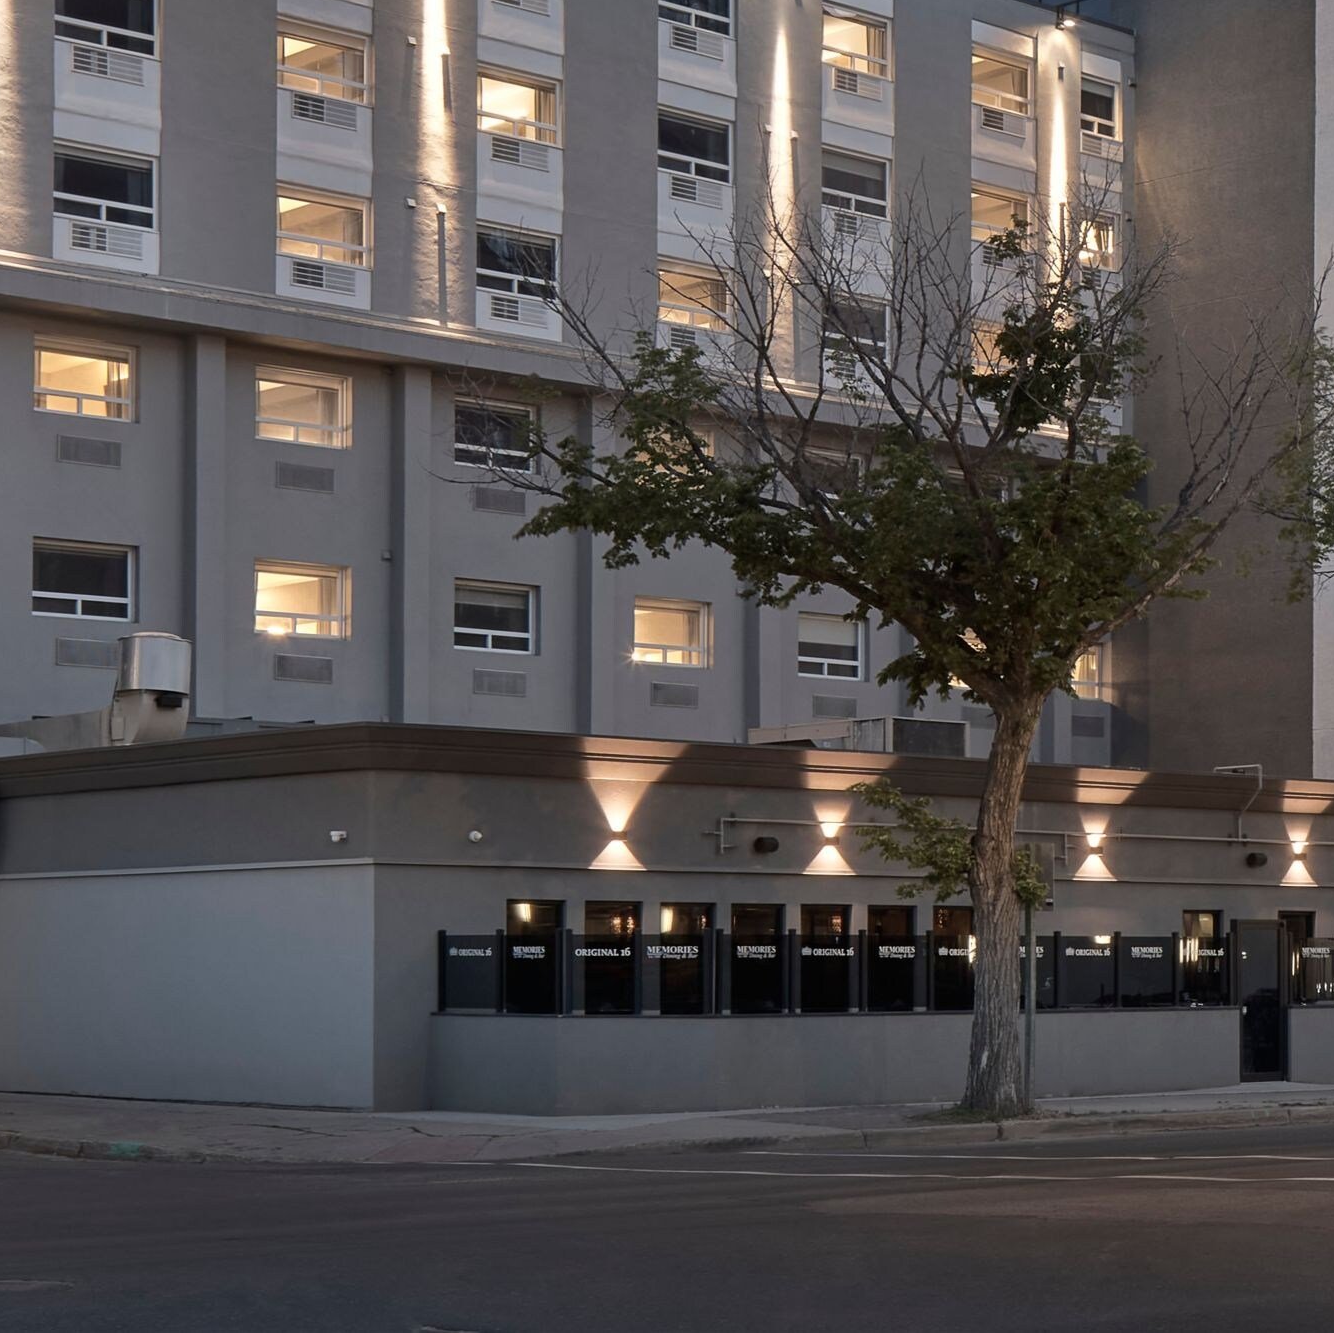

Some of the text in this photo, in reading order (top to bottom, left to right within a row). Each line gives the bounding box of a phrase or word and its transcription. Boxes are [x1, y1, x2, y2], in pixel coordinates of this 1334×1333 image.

[512, 946, 545, 954] MEMORIES
[620, 947, 631, 956] 16
[647, 946, 699, 954] MEMORIES
[737, 946, 776, 954] MEMORIES
[846, 947, 854, 956] 16
[878, 946, 915, 954] MEMORIES
[1131, 946, 1163, 954] MEMORIES
